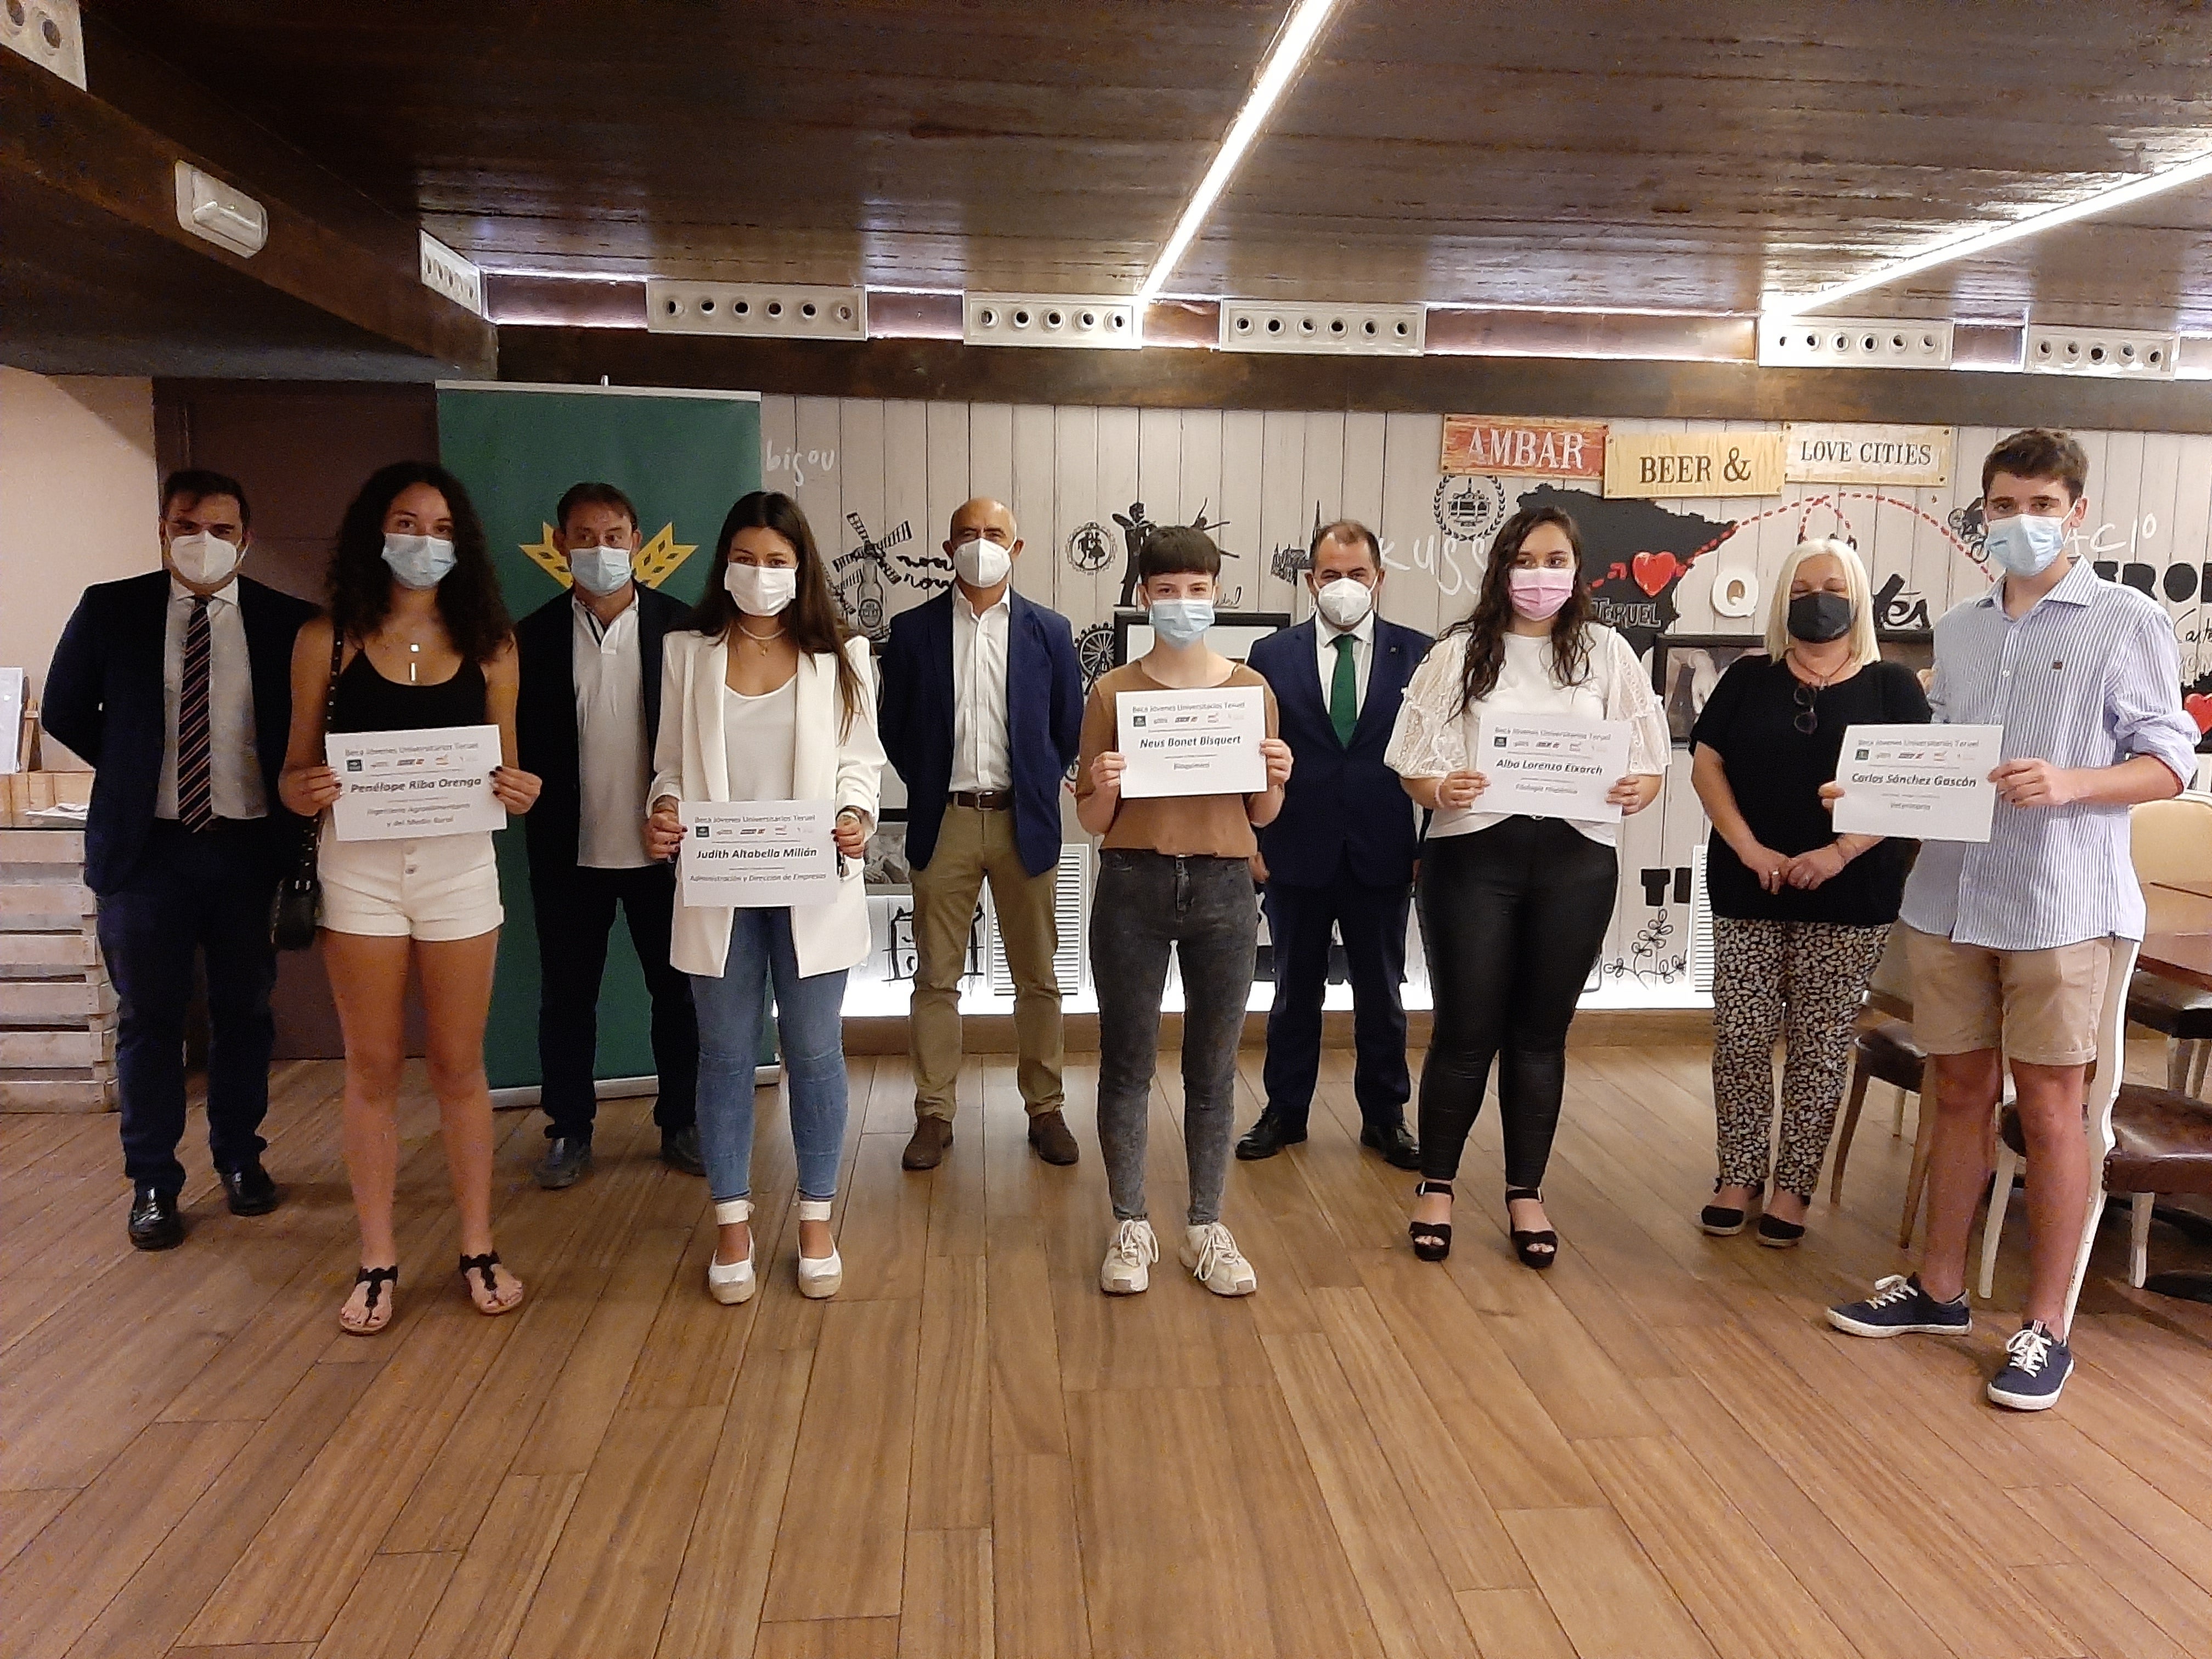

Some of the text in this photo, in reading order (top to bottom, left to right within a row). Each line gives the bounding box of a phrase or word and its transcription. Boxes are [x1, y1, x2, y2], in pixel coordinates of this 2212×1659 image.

[1468, 426, 1583, 470] AMBAR
[1801, 439, 1932, 466] LOVE CITIES
[1639, 446, 1752, 483] BEER &
[1139, 735, 1241, 748] Neus Bonet Bisquert
[1496, 759, 1520, 769] Alba
[1852, 772, 1977, 787] Carlos Sánchez Gascón
[696, 848, 817, 859] Judith Altabella Milián
